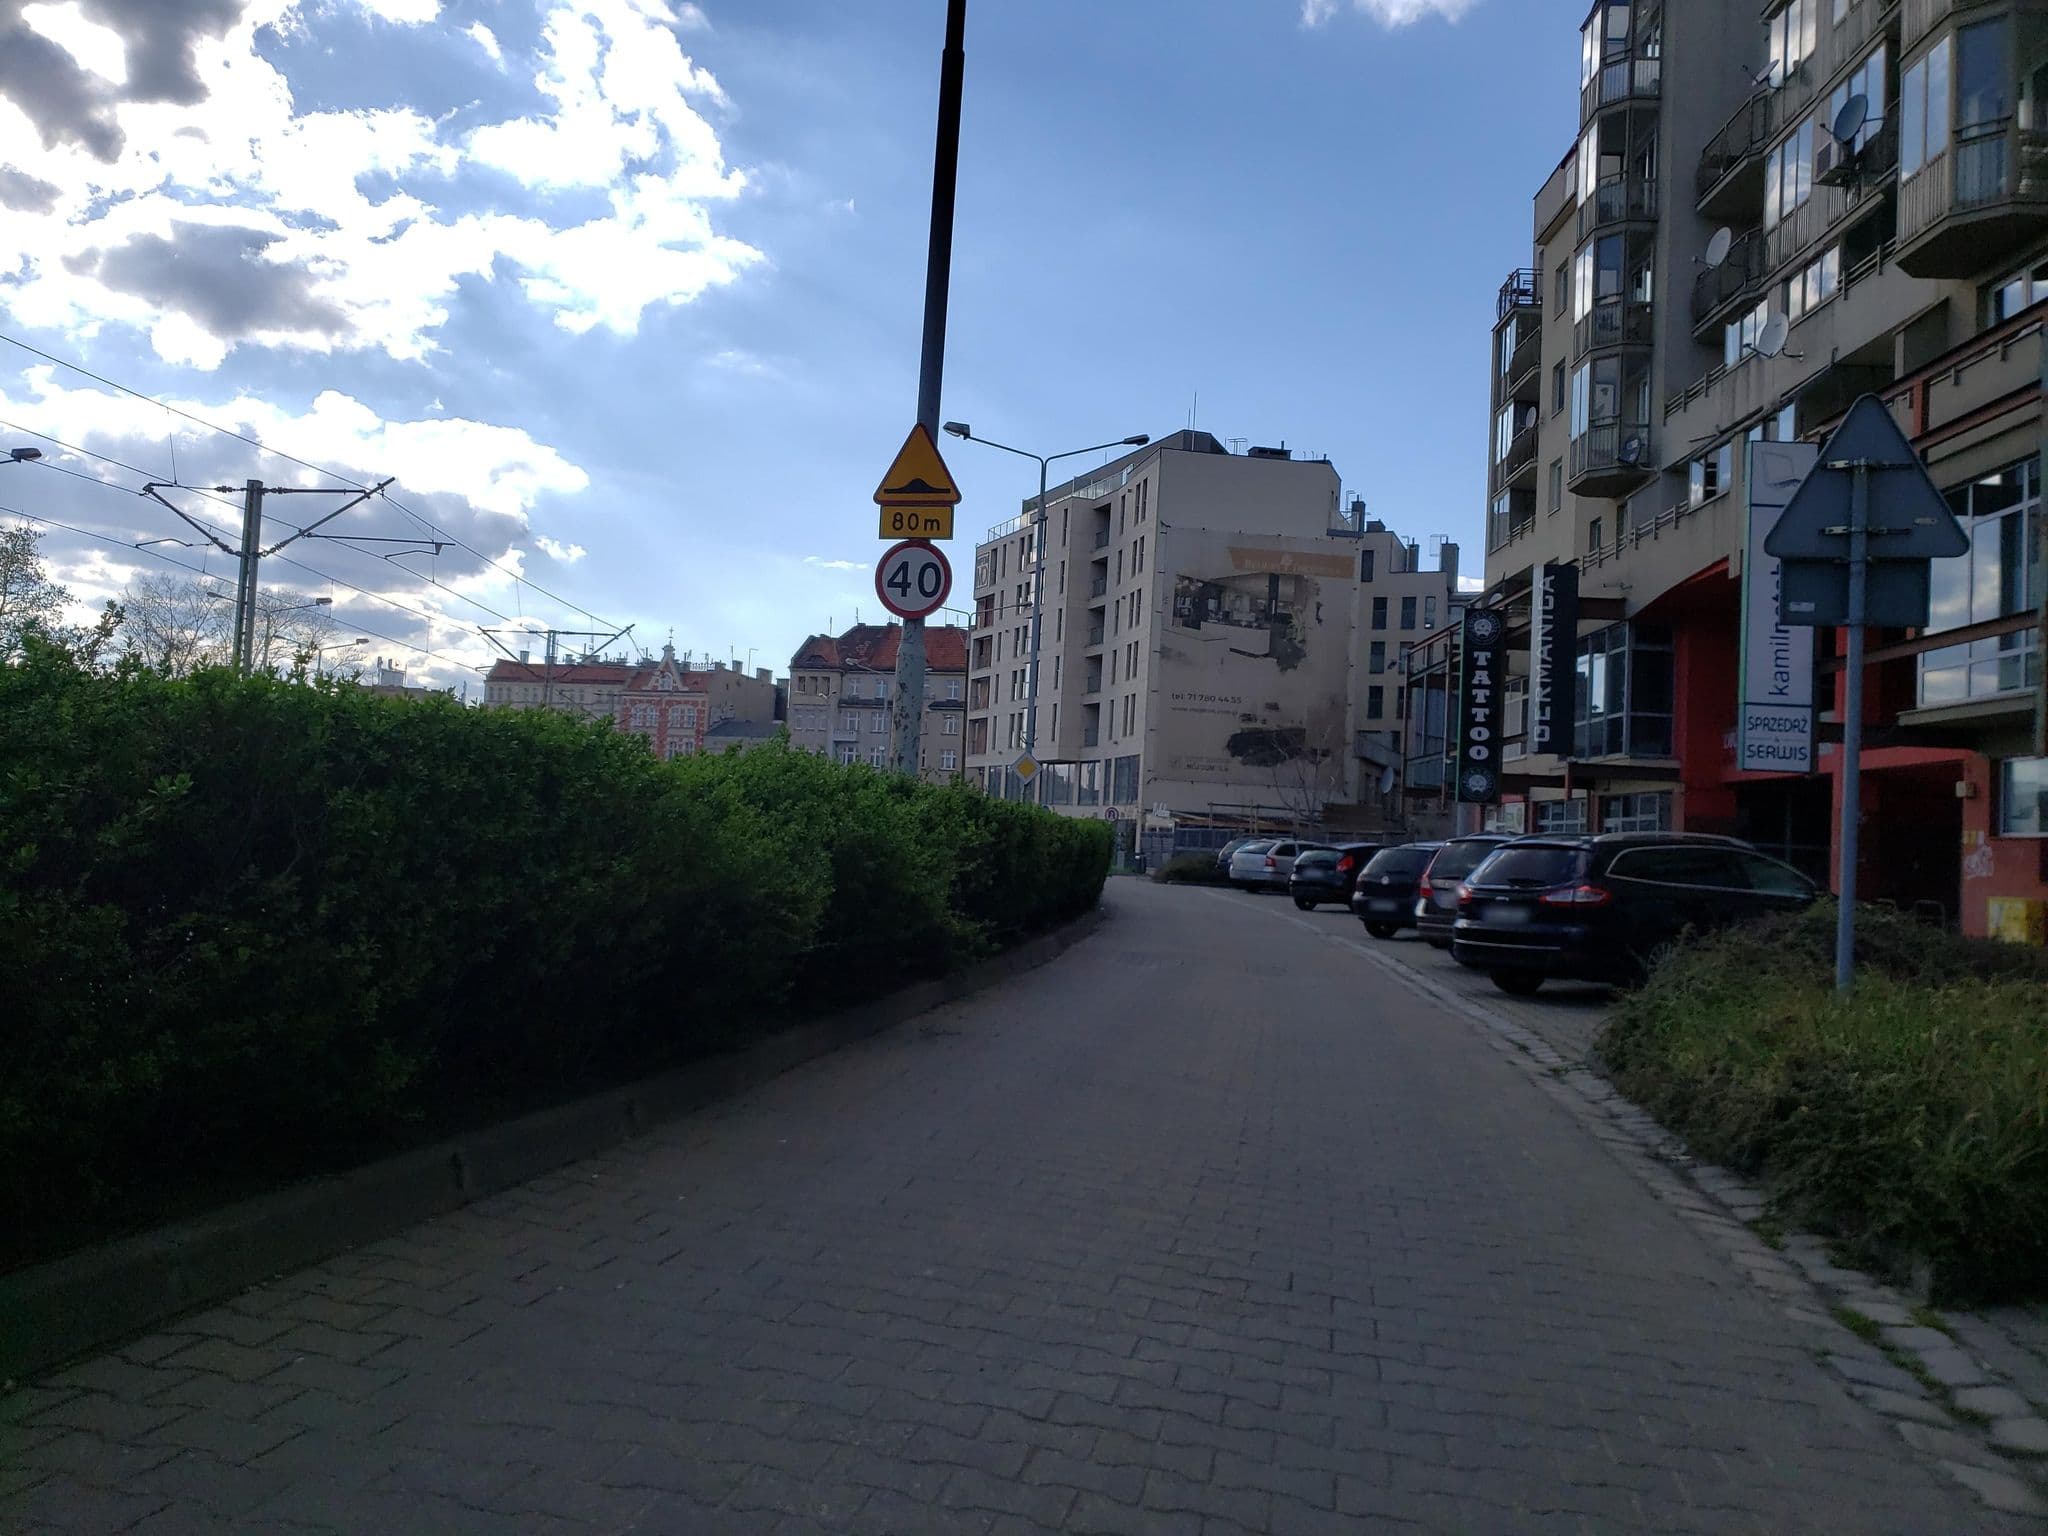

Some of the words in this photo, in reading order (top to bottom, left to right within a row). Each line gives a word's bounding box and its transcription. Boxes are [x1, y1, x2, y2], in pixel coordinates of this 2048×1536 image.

[887, 561, 941, 598] 40
[1469, 651, 1492, 761] TATTOO
[1746, 744, 1808, 761] SERWIS
